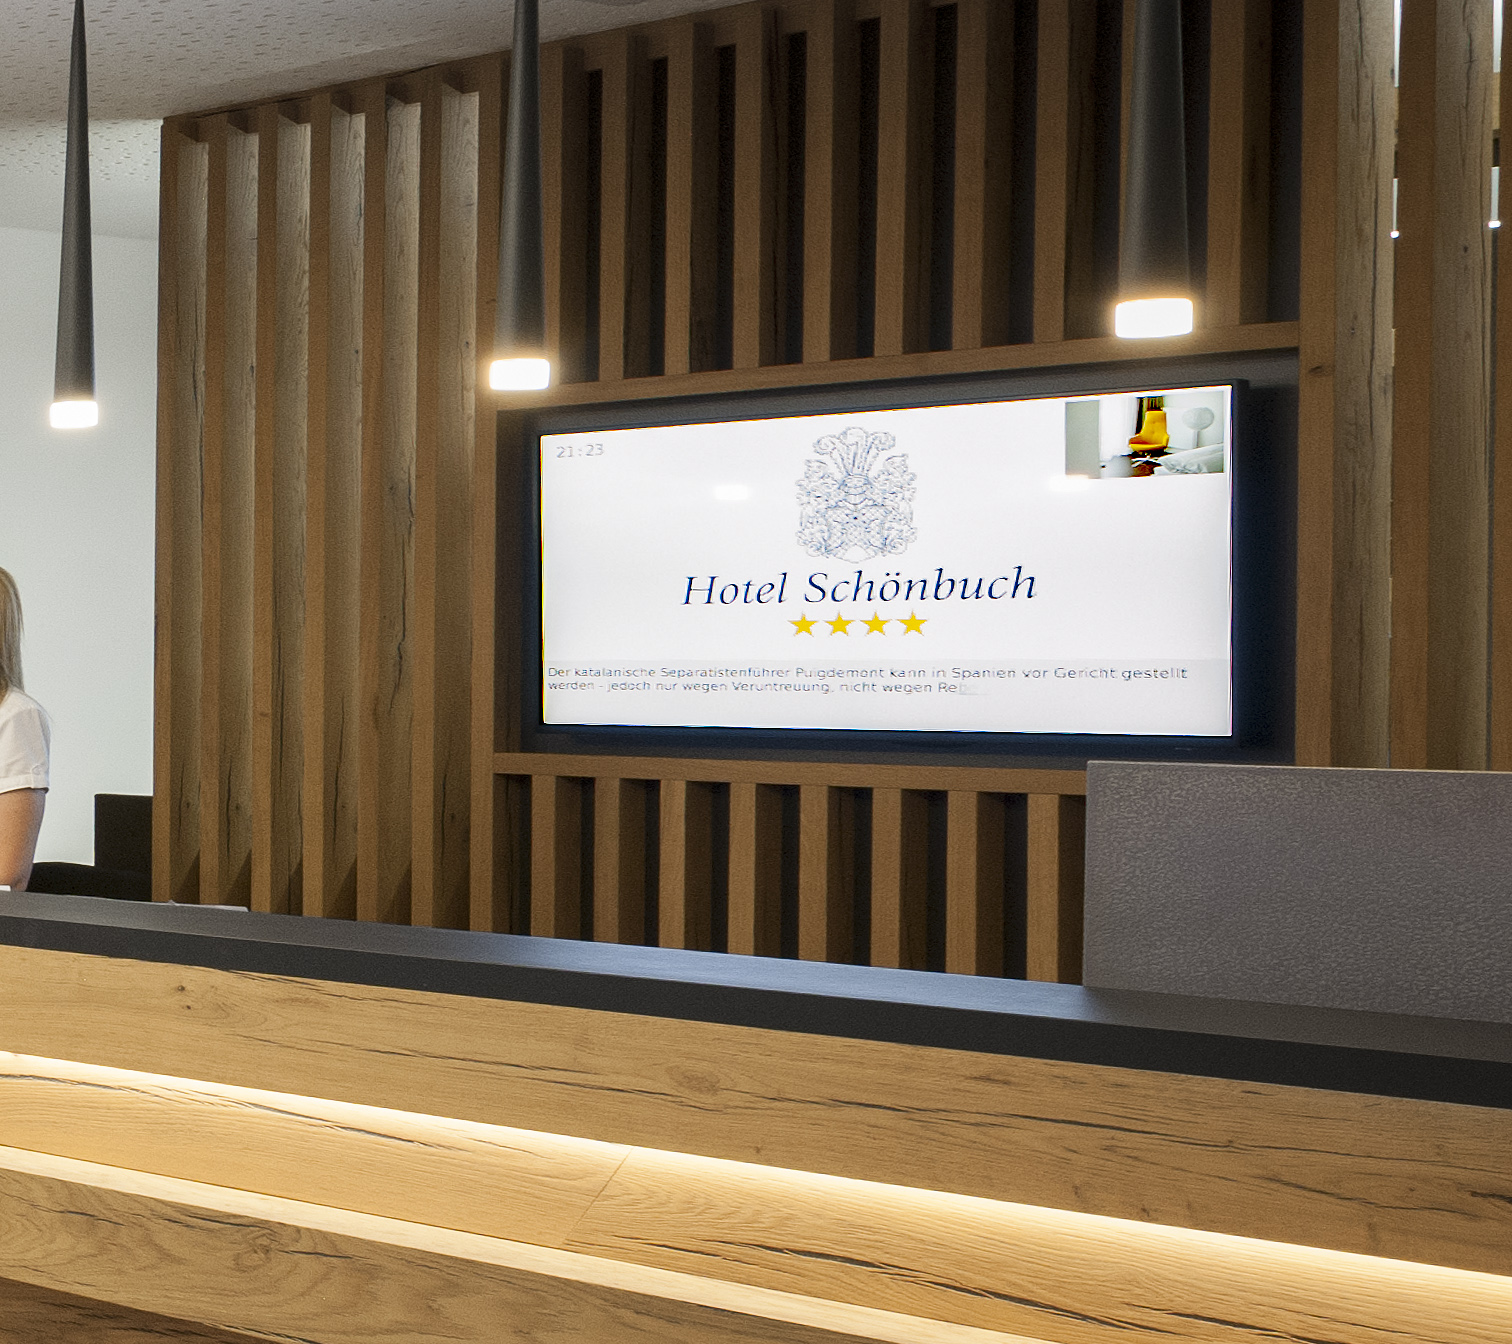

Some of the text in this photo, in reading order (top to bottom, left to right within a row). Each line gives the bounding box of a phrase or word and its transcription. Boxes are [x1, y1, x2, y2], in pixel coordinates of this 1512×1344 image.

[556, 443, 604, 459] 21:23
[684, 565, 1037, 604] Hotel Schönbuch
[548, 667, 569, 678] Der
[574, 667, 656, 678] katalanische
[890, 669, 926, 678] kann
[951, 667, 1016, 681] Spanien
[1022, 669, 1049, 679] vor
[1053, 667, 1116, 679] Gericht
[1121, 667, 1188, 682] gestellt
[547, 681, 594, 691] werden
[656, 682, 678, 691] nur
[682, 683, 728, 694] wegen
[882, 684, 933, 695] wegen
